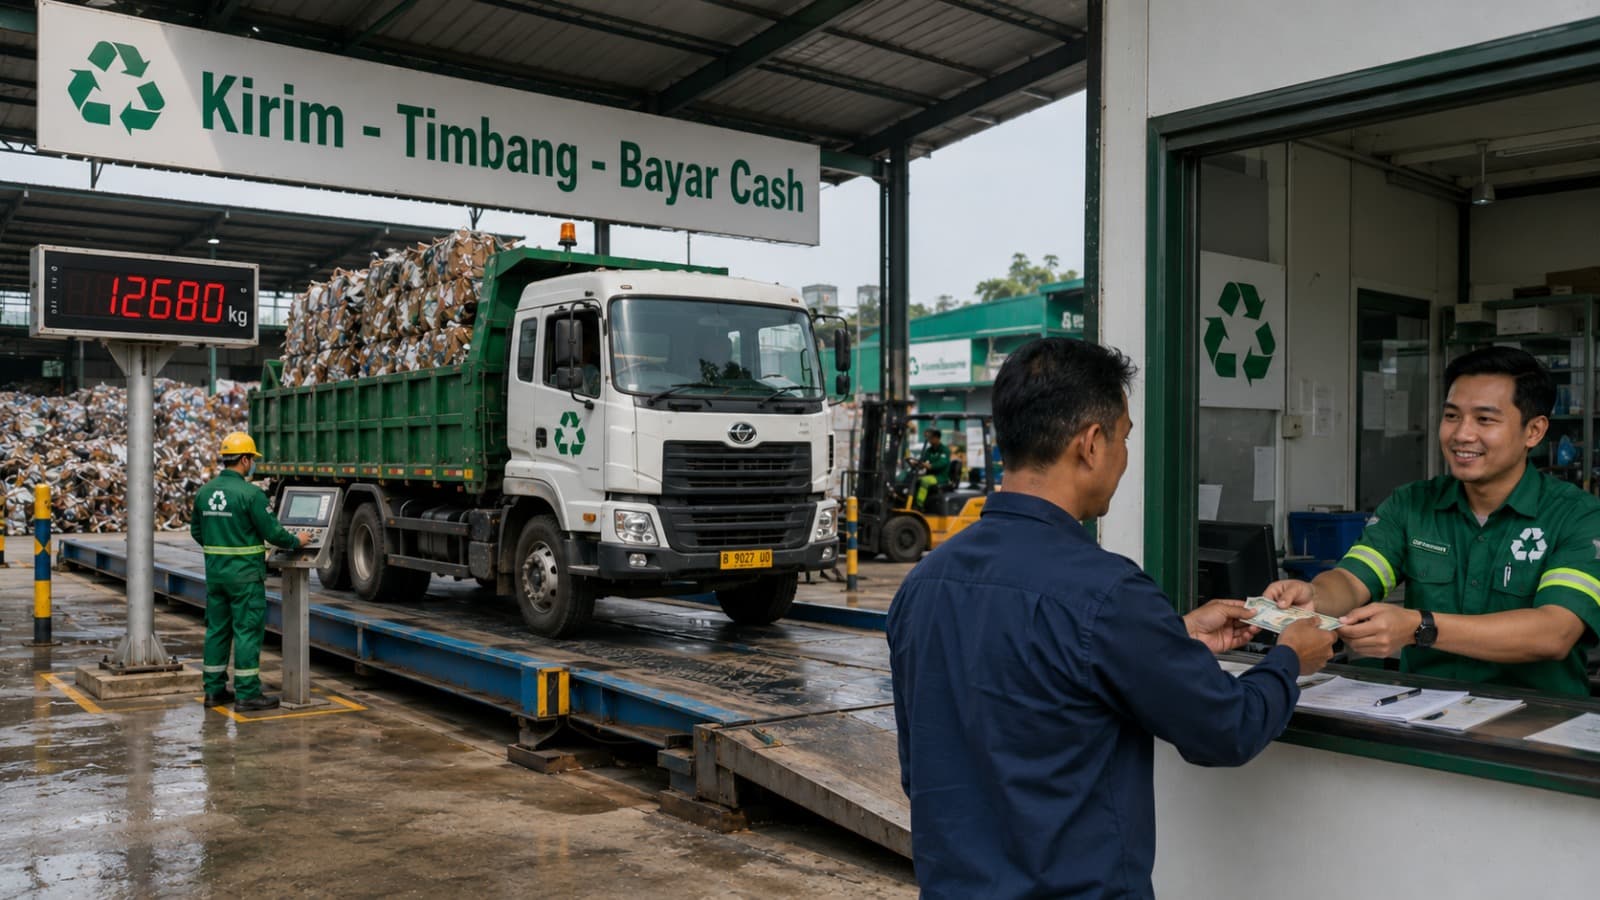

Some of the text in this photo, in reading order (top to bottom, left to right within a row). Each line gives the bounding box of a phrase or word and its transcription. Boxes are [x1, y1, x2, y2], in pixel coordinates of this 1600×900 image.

[202, 72, 804, 212] Kirim - Timbang - Bayar Cash
[110, 276, 248, 327] 12680 kg
[722, 553, 729, 564] B
[734, 552, 755, 564] 9027
